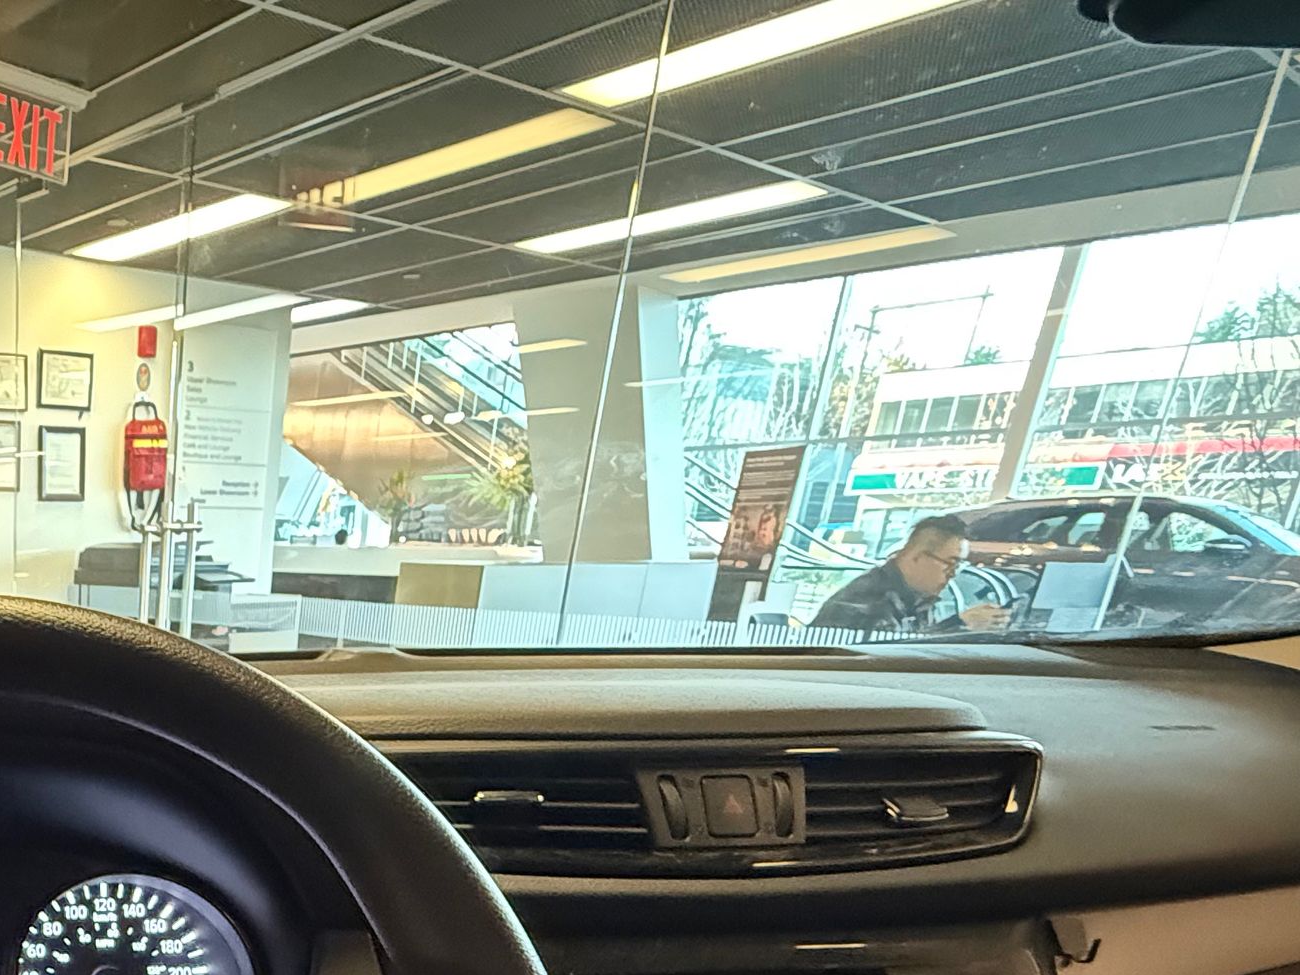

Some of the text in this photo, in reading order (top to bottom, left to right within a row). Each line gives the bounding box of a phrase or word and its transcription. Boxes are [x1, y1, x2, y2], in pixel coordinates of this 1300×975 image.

[187, 361, 194, 373] 3
[184, 410, 191, 421] 2
[64, 905, 87, 920] 100
[93, 898, 116, 912] 120
[122, 903, 146, 919] 140
[42, 921, 62, 937] 80
[143, 918, 167, 934] 160
[26, 943, 46, 959] 60
[160, 938, 183, 955] 180
